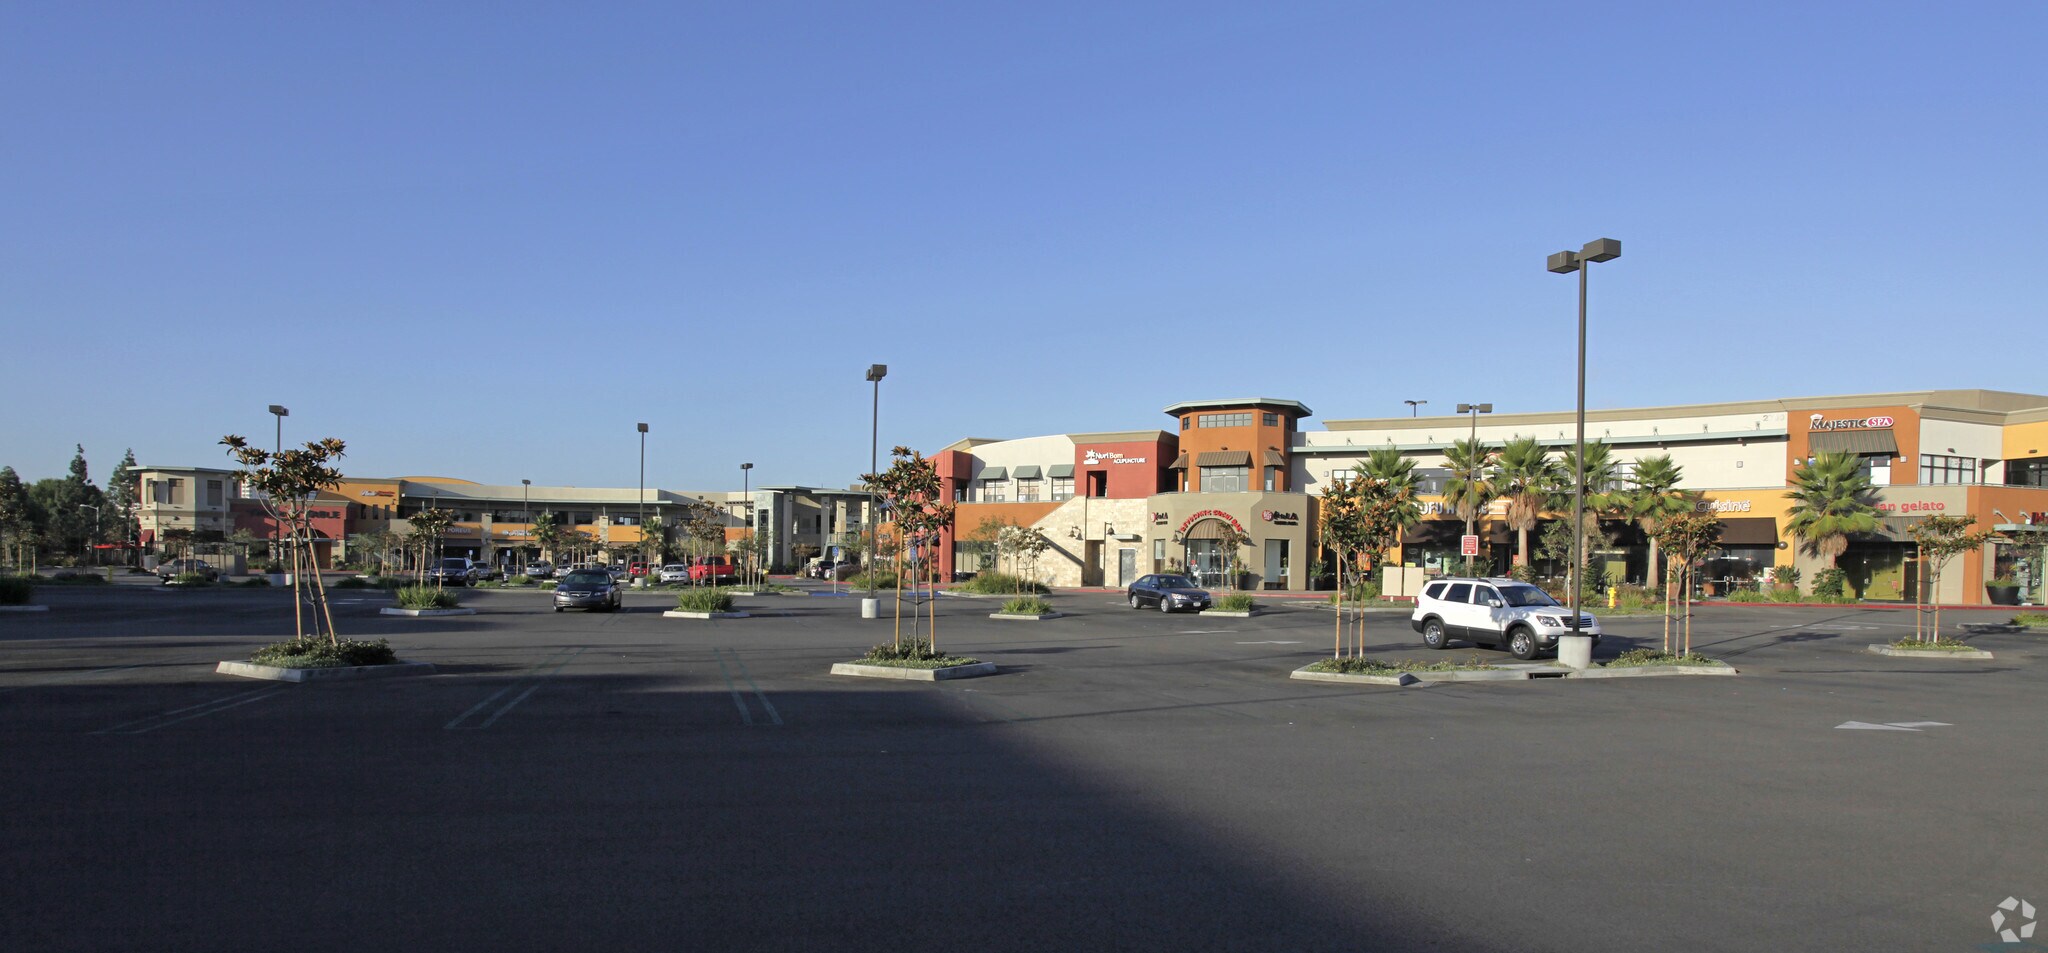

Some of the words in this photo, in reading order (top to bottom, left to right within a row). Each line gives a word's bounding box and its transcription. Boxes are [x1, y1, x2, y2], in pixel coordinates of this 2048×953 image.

[1810, 418, 1867, 431] MAJESTIC
[1871, 417, 1890, 426] SPA
[1901, 500, 1945, 513] gelato
